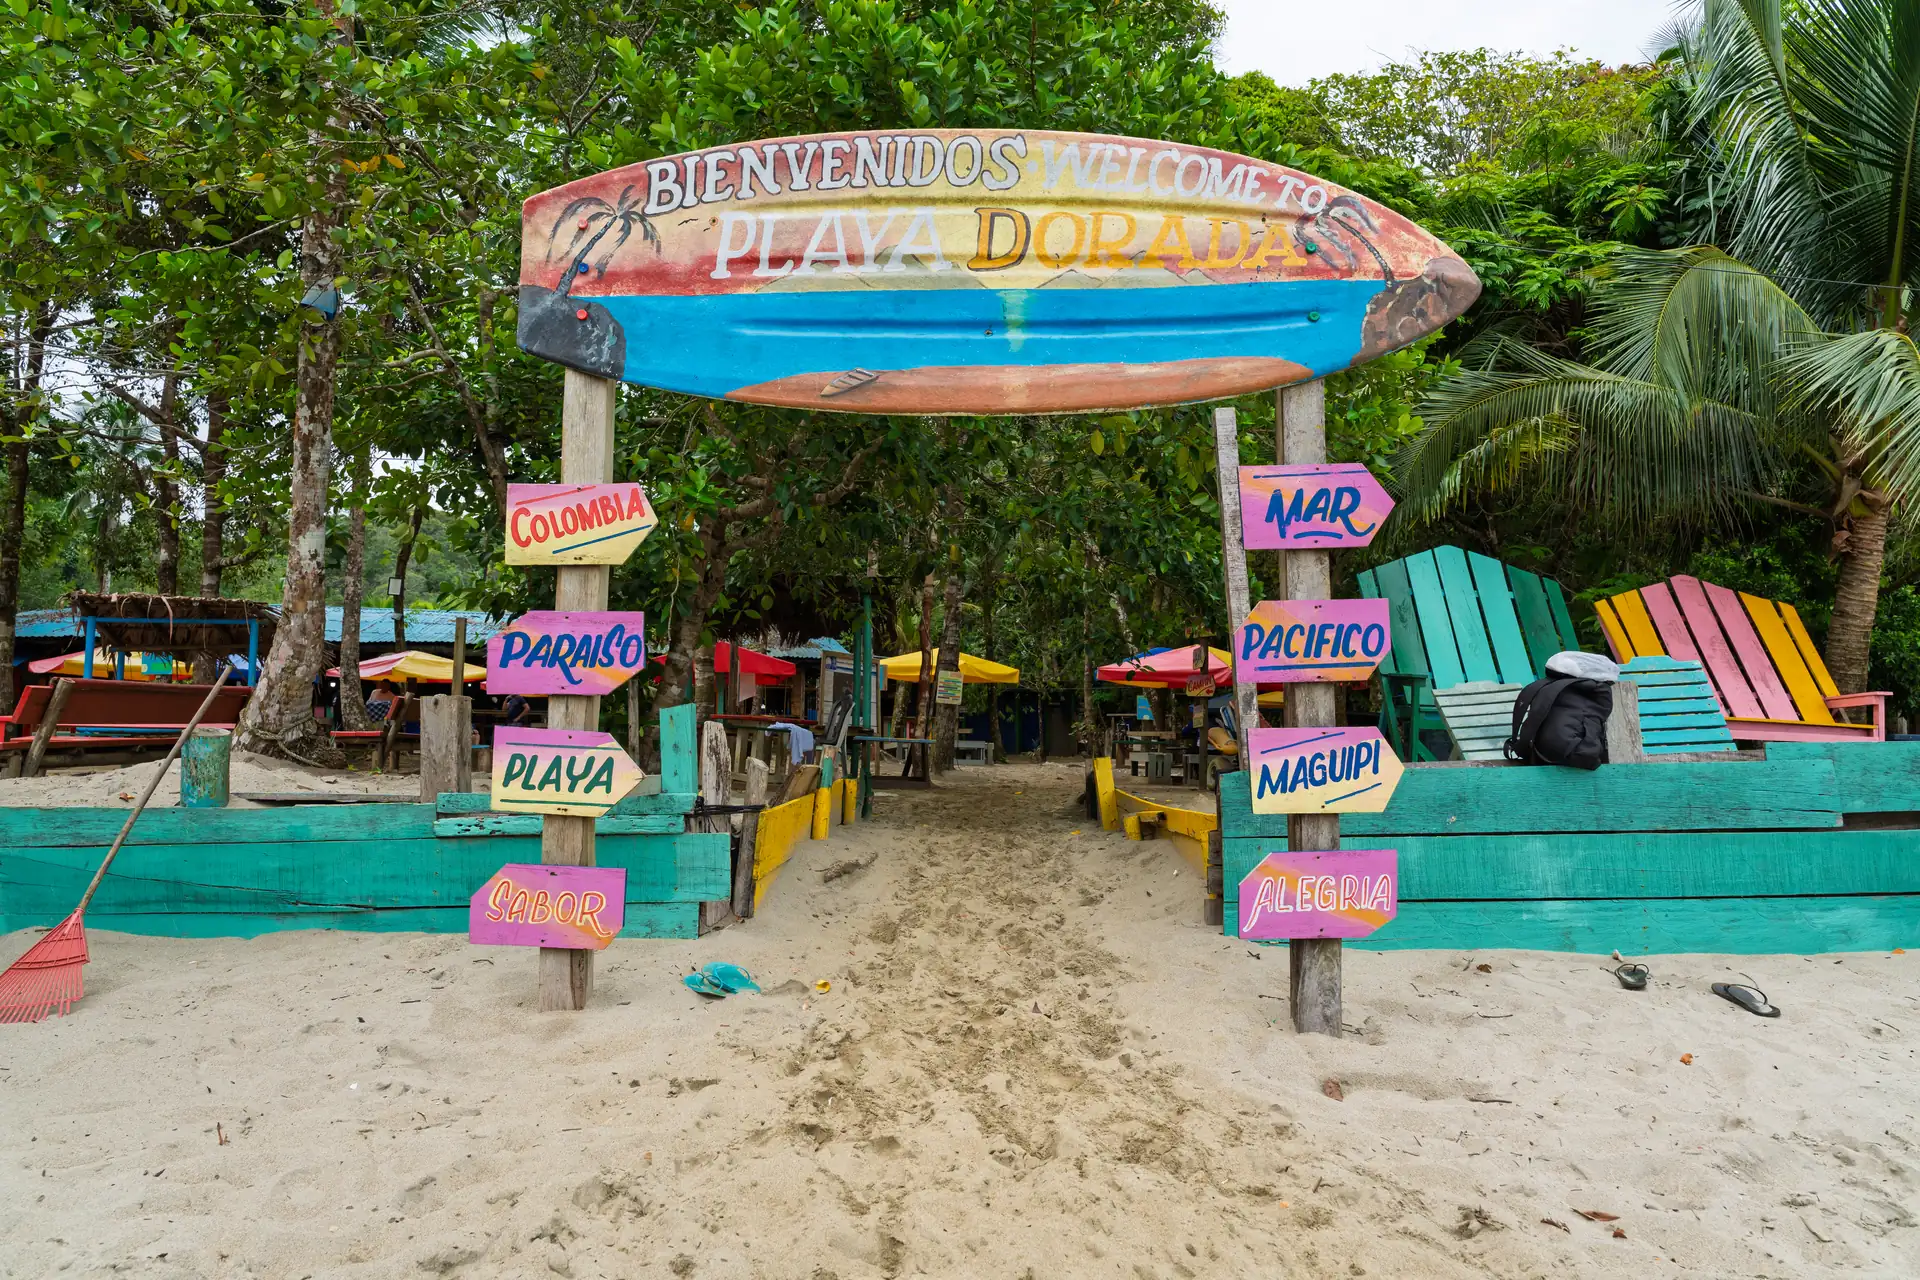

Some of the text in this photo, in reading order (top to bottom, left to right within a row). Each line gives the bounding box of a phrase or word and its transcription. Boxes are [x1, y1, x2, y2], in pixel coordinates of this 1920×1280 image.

[643, 133, 1327, 216] BIENVENIDOS WELCOME TO
[710, 206, 1308, 280] PLAYA DORADA
[511, 488, 645, 548] COLOMBIA
[1265, 486, 1376, 539] MAR
[499, 624, 642, 685] PARAISO
[1242, 623, 1384, 661] PACIFICO
[502, 753, 614, 794] PLAYA
[1257, 739, 1381, 799] MAGUIPI
[486, 878, 613, 937] SABOR
[1243, 874, 1392, 933] ALEGRIA
